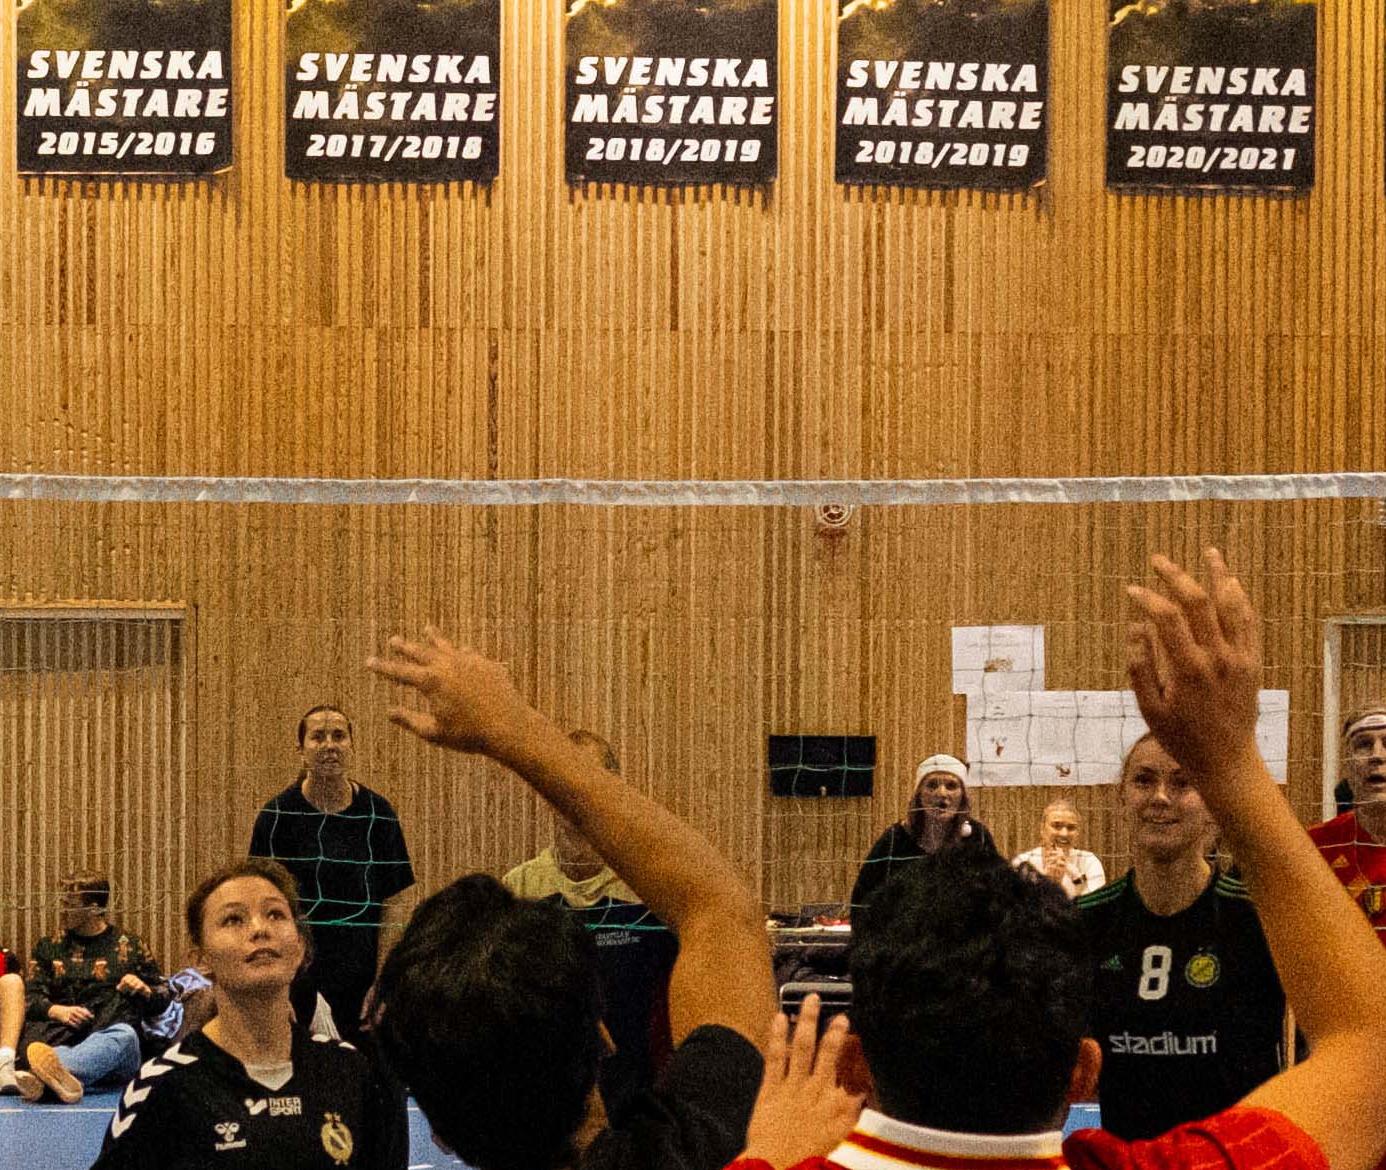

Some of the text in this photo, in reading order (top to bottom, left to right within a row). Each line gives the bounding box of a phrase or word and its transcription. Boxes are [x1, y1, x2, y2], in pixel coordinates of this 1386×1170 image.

[26, 49, 223, 80] SVENSKA
[295, 52, 491, 84] SVENSKA
[575, 56, 769, 88] SVENSKA
[846, 59, 1038, 93] SVENSKA
[1118, 64, 1306, 97] SVENSKA
[23, 80, 229, 118] MÄSTARE
[292, 83, 497, 122] MÄSTARE
[571, 86, 775, 126] MÄSTARE
[841, 89, 1043, 130] MÄSTARE
[1114, 95, 1312, 134] MÄSTARE
[37, 131, 216, 159] 2015/2016
[306, 134, 483, 162] 2017/2018
[585, 137, 762, 166] 2018/2019
[855, 140, 1030, 169] 2018/2019
[1126, 145, 1296, 173] 2020/2021
[1138, 945, 1172, 1000] 8
[1109, 1031, 1216, 1055] stadium
